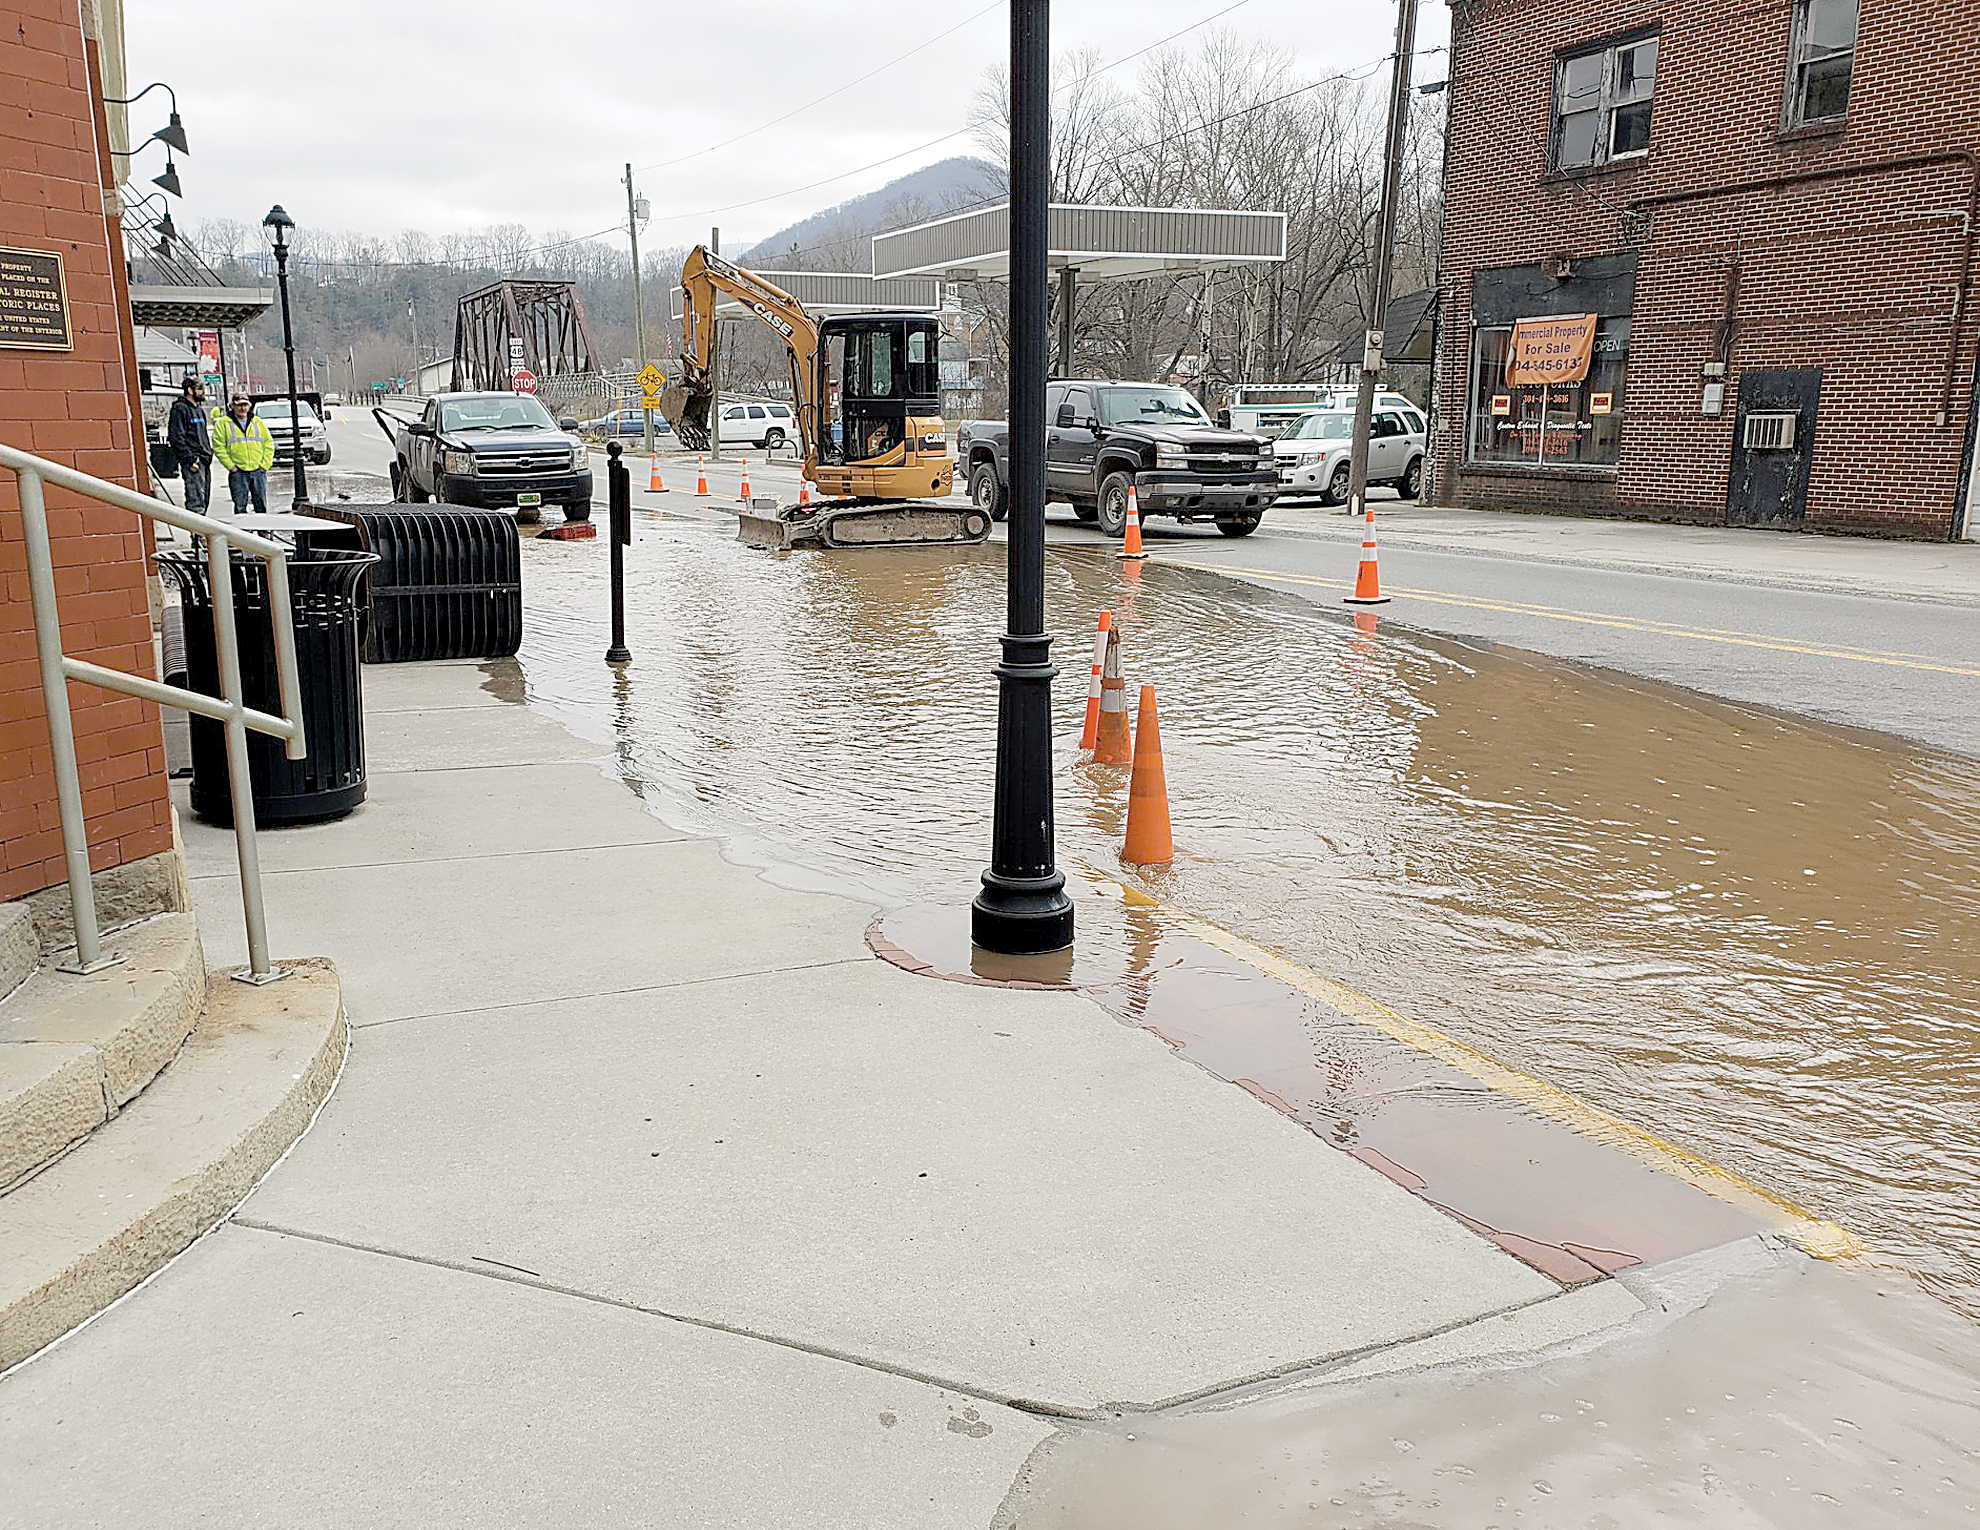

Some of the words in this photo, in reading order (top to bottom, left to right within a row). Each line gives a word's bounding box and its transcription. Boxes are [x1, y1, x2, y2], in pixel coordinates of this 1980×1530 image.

[1, 263, 31, 271] PROPERTY
[14, 289, 57, 300] REGISTER
[26, 302, 60, 311] PLACES
[753, 302, 793, 336] CASE
[1554, 324, 1588, 339] Property
[1525, 342, 1543, 355] For
[1545, 341, 1571, 354] Sale
[1593, 340, 1621, 353] OPEN
[514, 378, 535, 389] STOP
[925, 432, 946, 444] CAS
